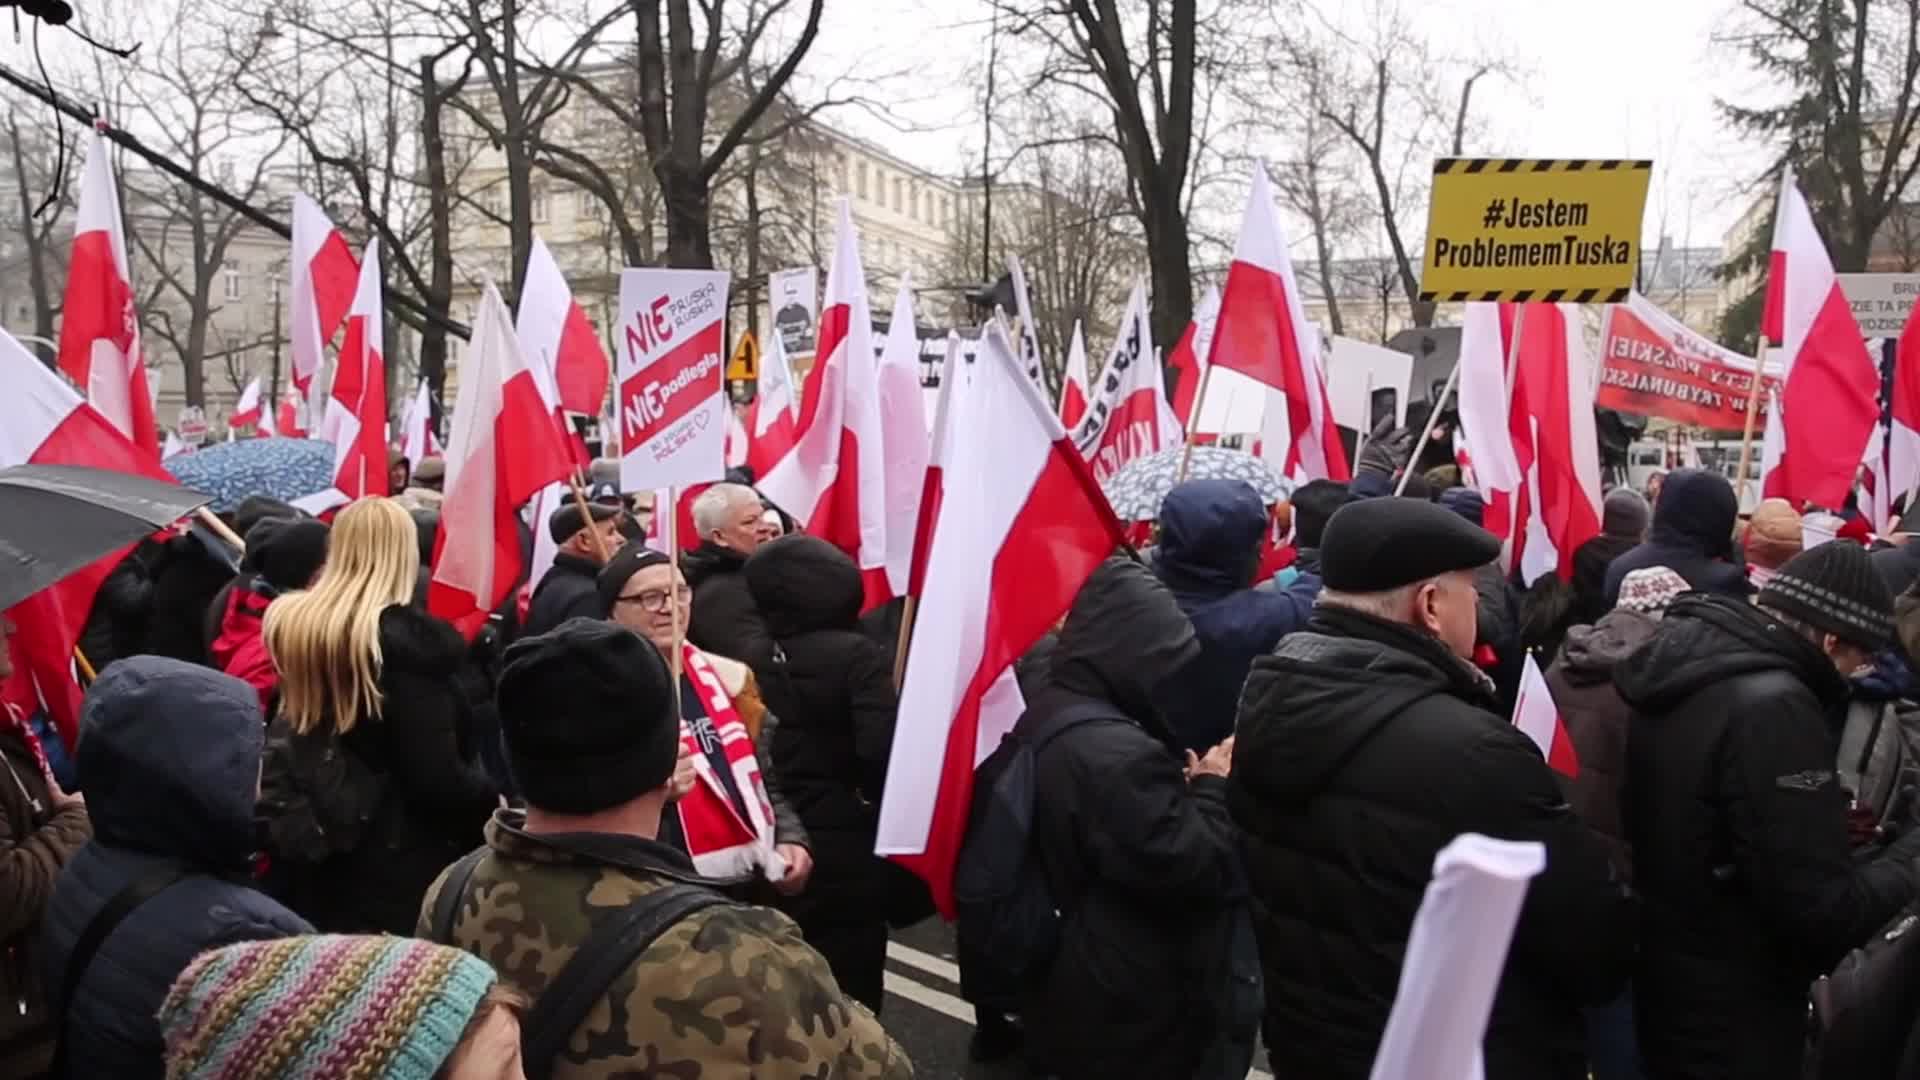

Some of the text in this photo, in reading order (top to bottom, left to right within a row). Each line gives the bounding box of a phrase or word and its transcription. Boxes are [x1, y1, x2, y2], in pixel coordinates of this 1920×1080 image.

[1483, 197, 1589, 229] #Jestem
[1433, 234, 1630, 268] ProblememTuska
[625, 281, 717, 364] NIE PRUSKA
[674, 298, 713, 328] RUSKA
